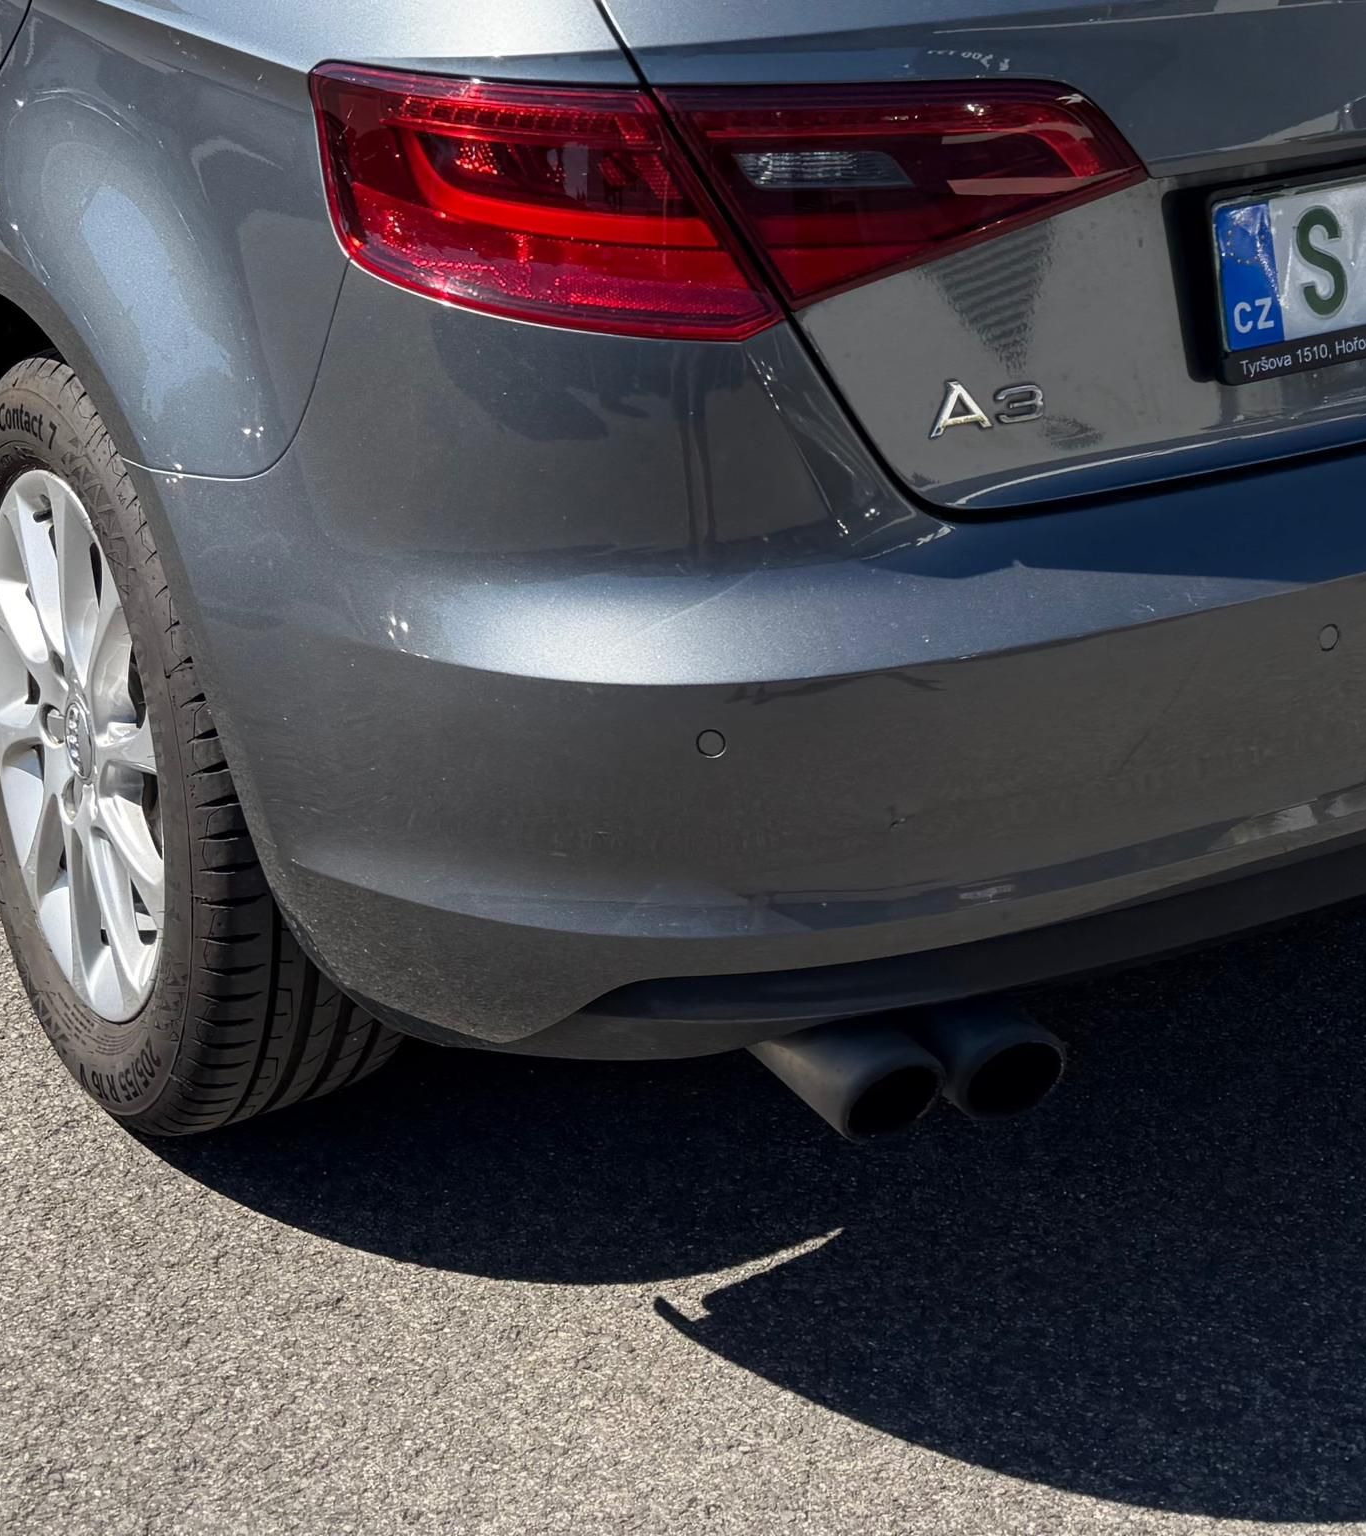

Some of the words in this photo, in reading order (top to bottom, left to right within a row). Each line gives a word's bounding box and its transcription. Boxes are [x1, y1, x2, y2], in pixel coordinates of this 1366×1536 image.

[1233, 296, 1276, 334] CZ
[1239, 353, 1293, 378] Tyršova
[1295, 343, 1333, 364] 1510,
[929, 380, 1044, 438] A3
[48, 420, 58, 450] 7
[117, 1035, 162, 1102] 205/55
